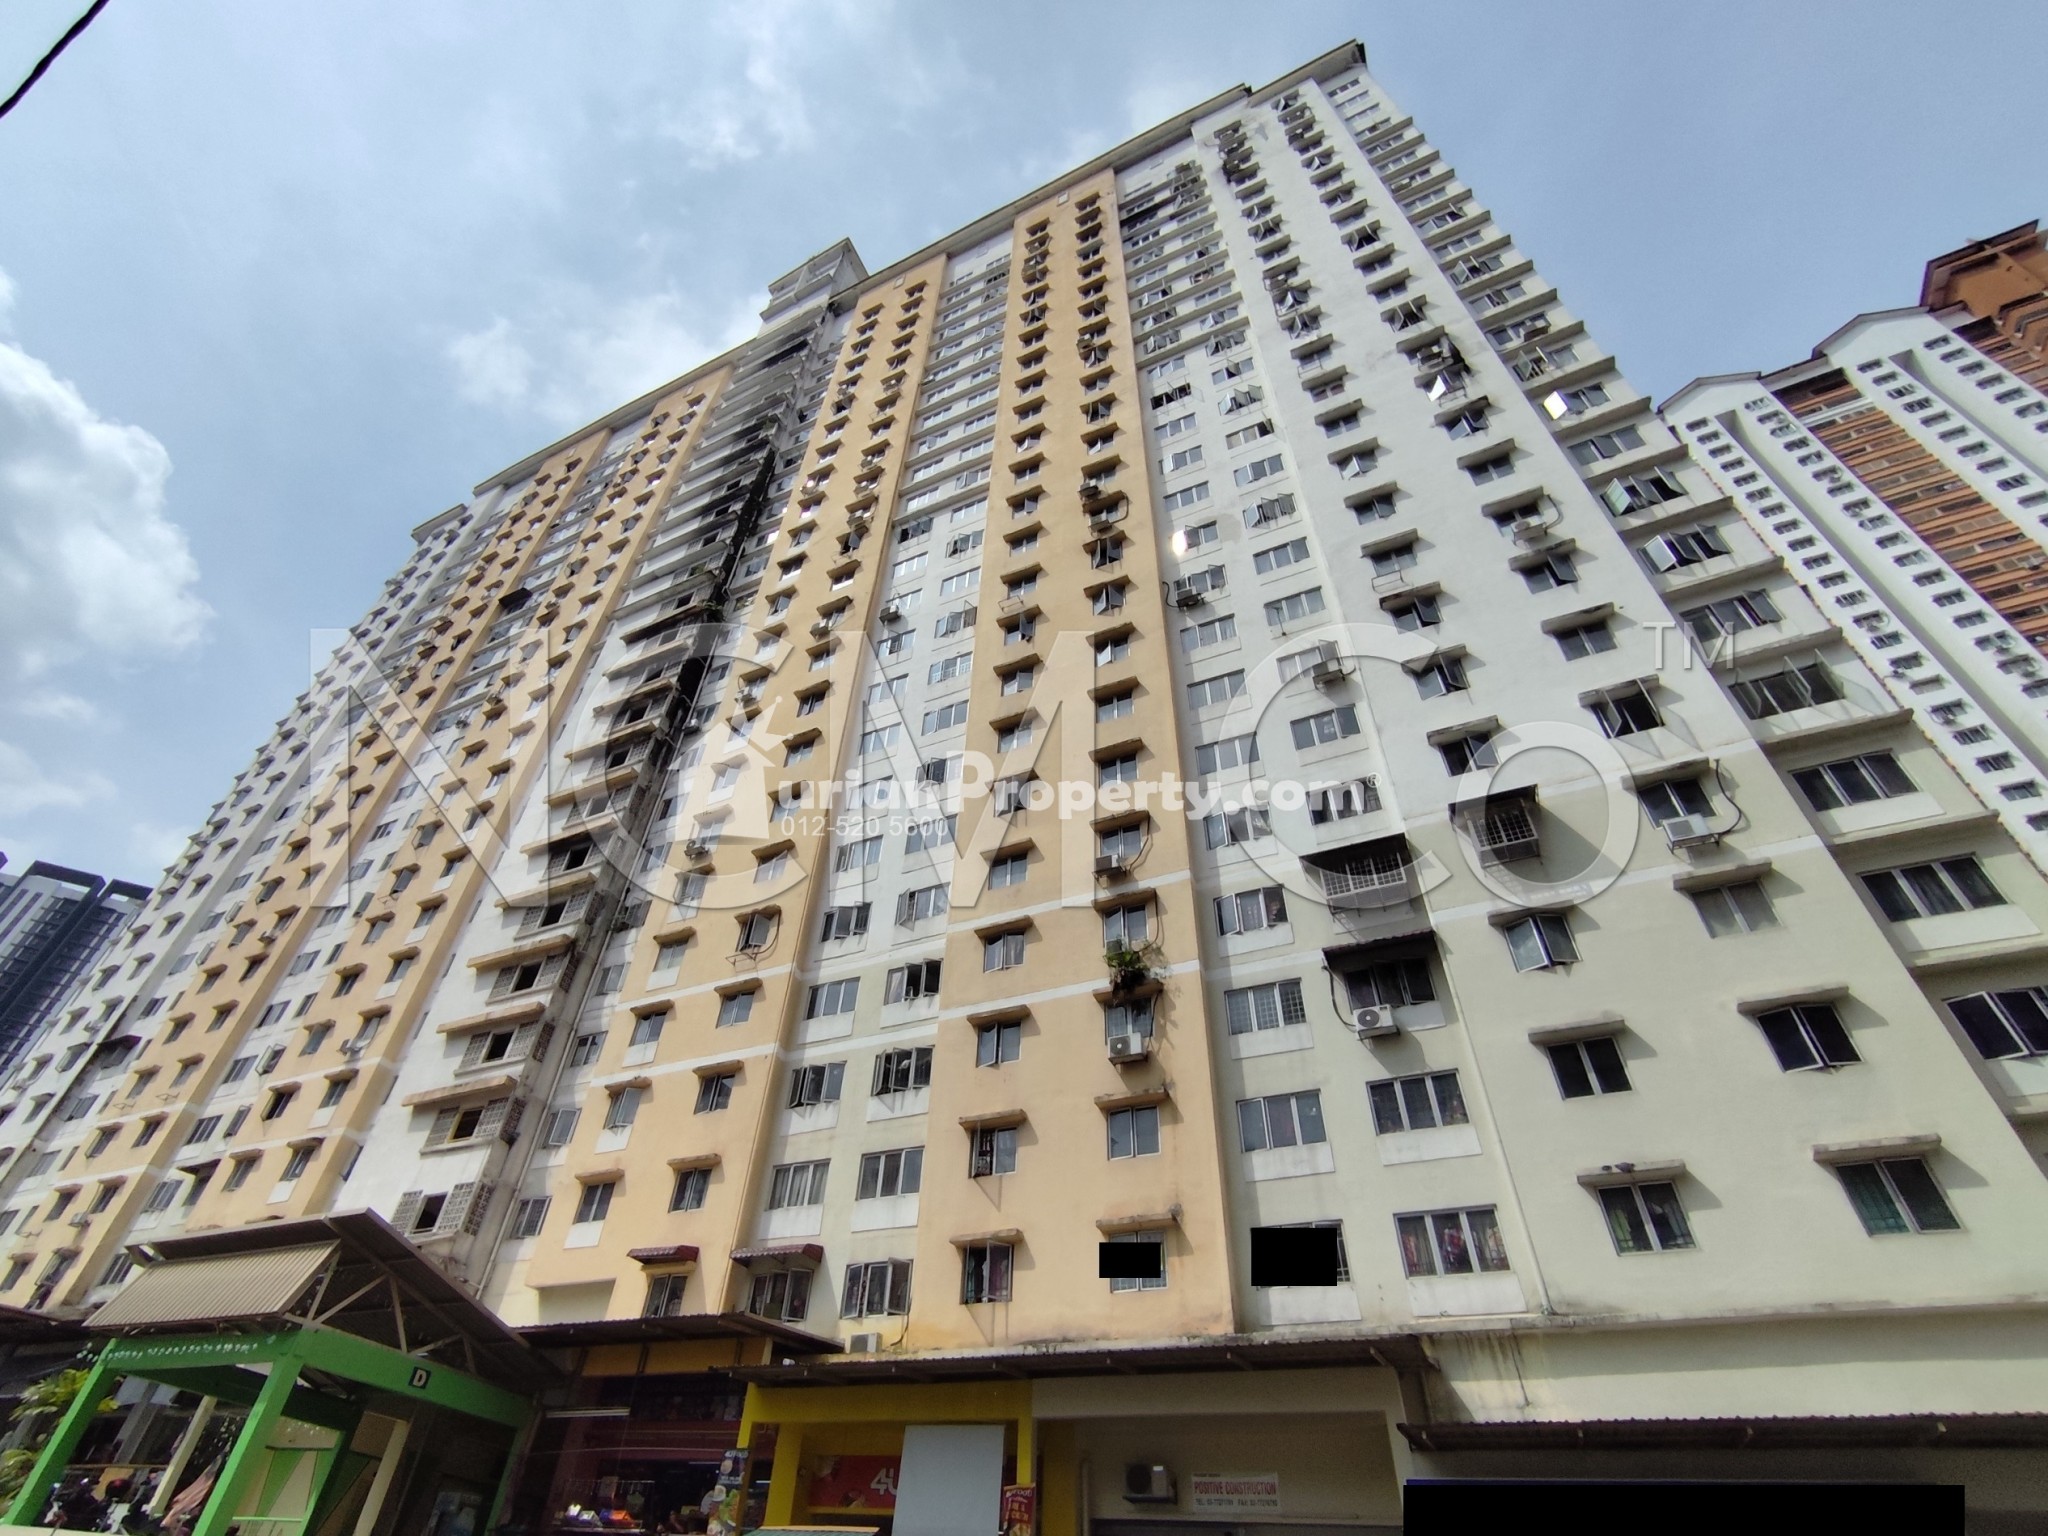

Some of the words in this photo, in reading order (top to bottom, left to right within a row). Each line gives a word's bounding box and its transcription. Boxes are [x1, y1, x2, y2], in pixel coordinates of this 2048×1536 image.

[412, 1369, 427, 1387] D
[1194, 1481, 1223, 1495] POSITIVE
[1225, 1481, 1277, 1496] CONSTRUCTION
